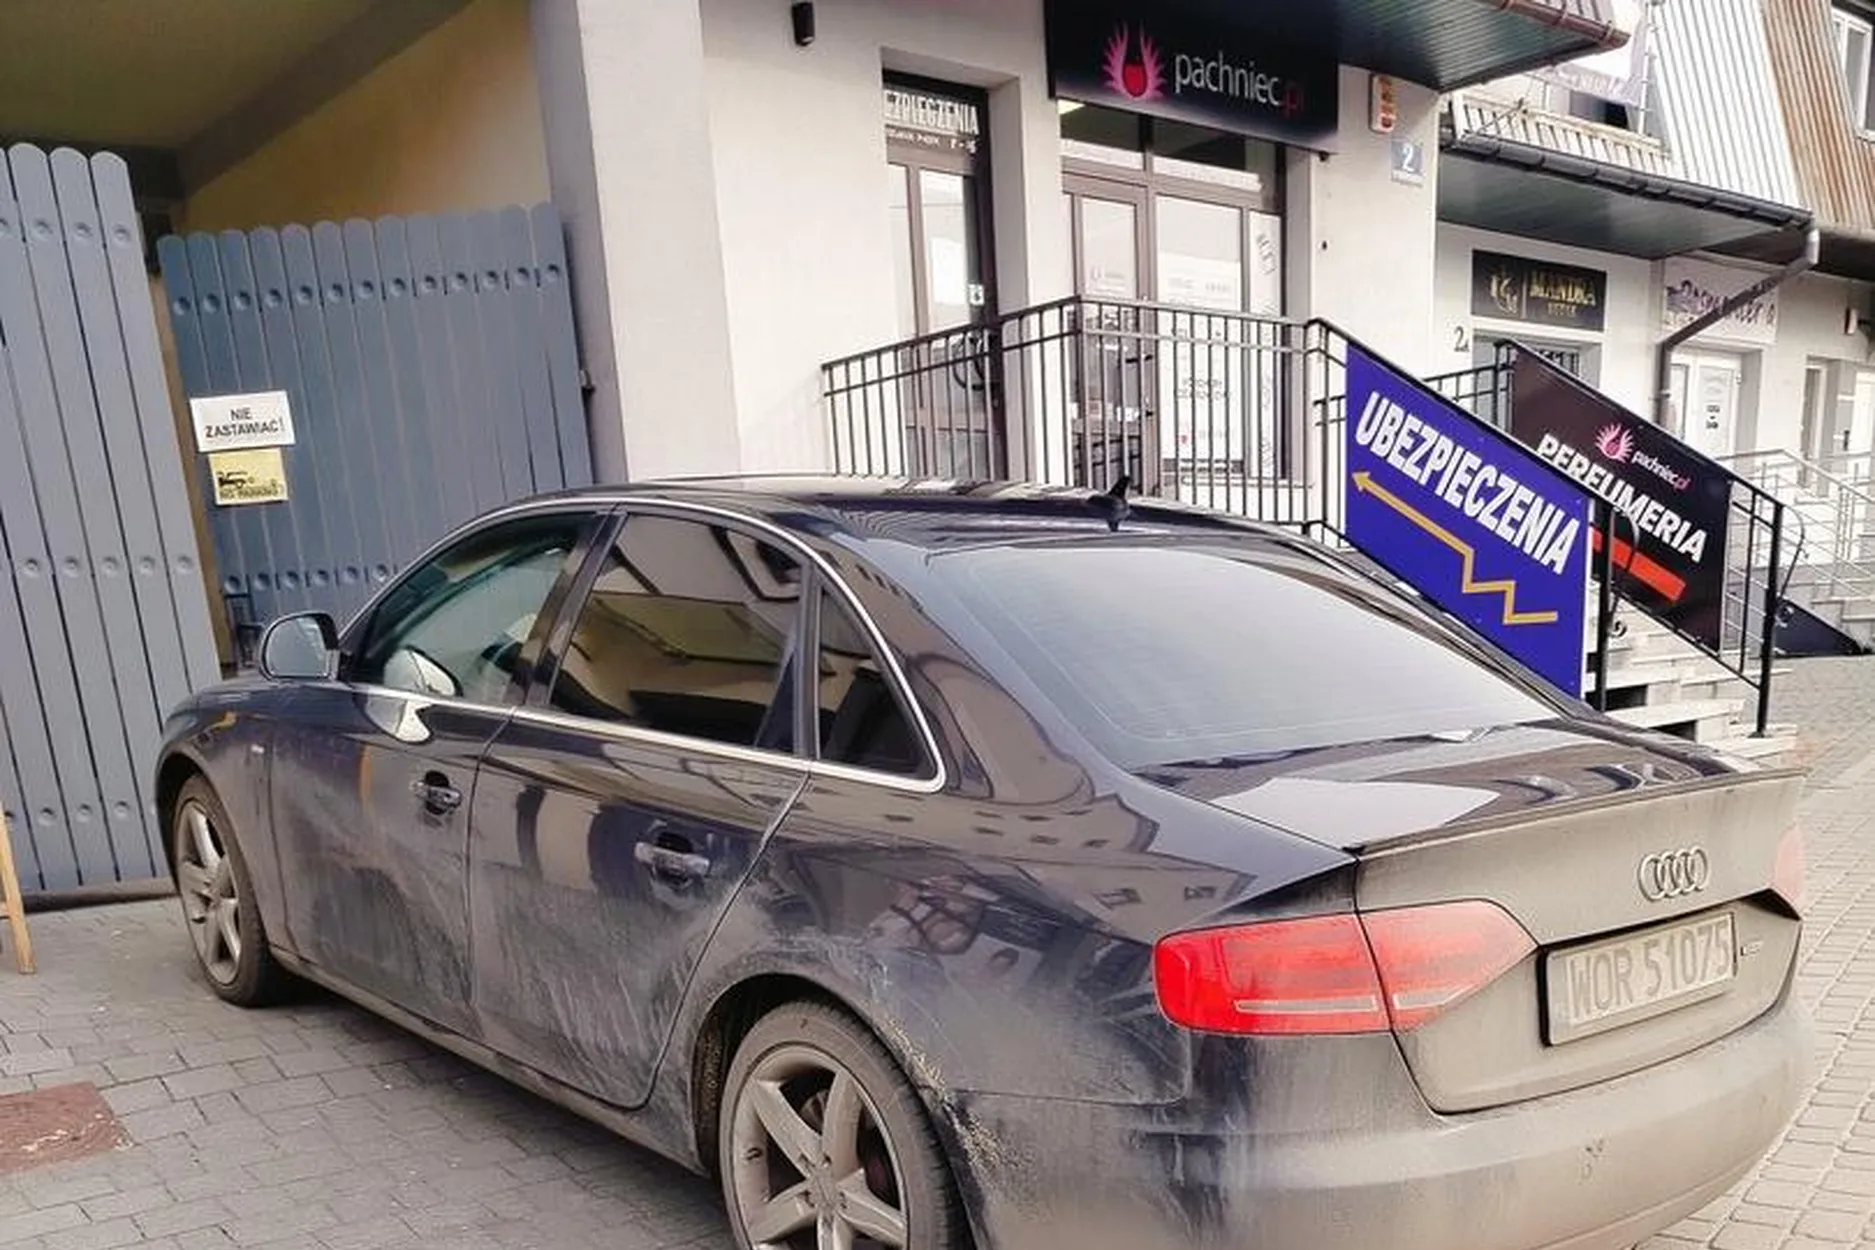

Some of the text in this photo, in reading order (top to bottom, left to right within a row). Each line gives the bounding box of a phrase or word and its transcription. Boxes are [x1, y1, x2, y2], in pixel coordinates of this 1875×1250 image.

[1402, 142, 1415, 172] 2
[230, 407, 253, 421] NIE
[1355, 392, 1580, 575] UBEZPIECZENIA
[1536, 433, 1707, 563] PERFUMERIA
[1570, 922, 1729, 1018] WOR 51075
